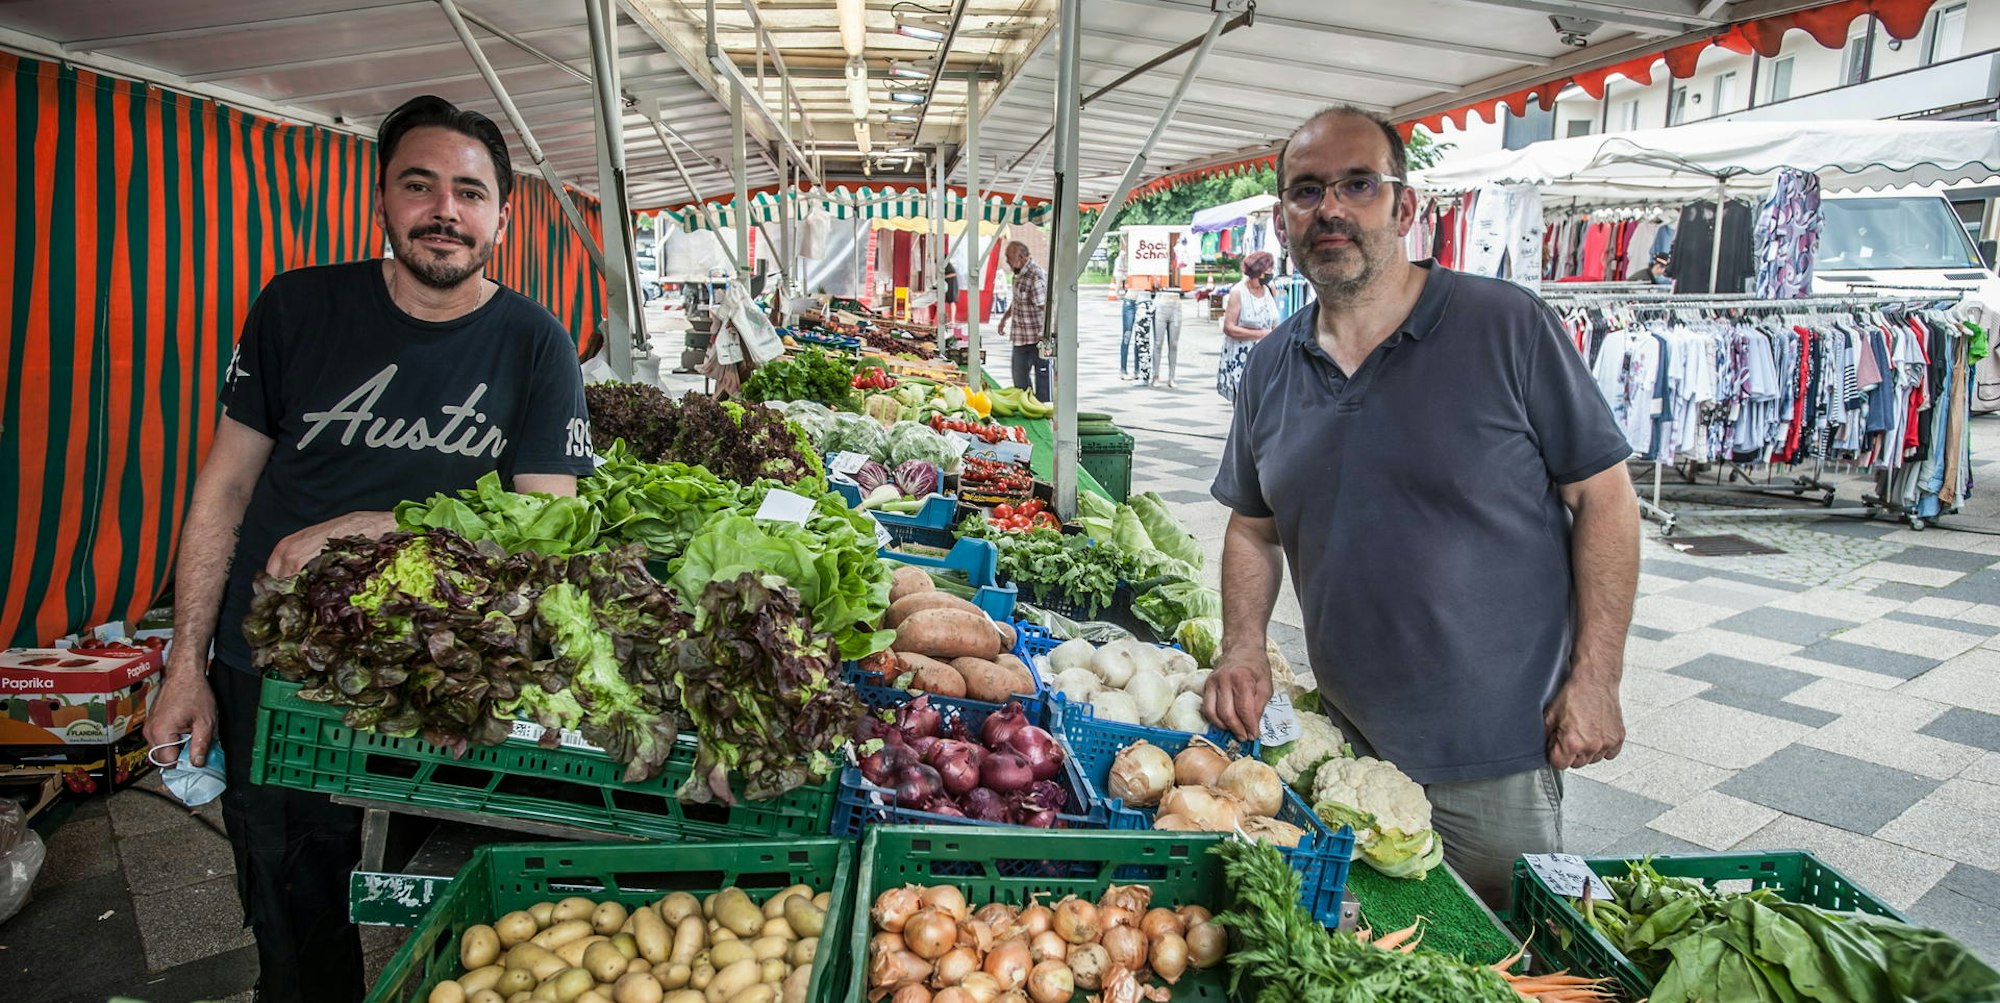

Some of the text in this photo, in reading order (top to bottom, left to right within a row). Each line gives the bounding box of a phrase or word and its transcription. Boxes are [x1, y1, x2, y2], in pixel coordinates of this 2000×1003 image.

[297, 364, 507, 457] Austin
[127, 661, 151, 679] Paprika
[1, 677, 54, 690] Paprika
